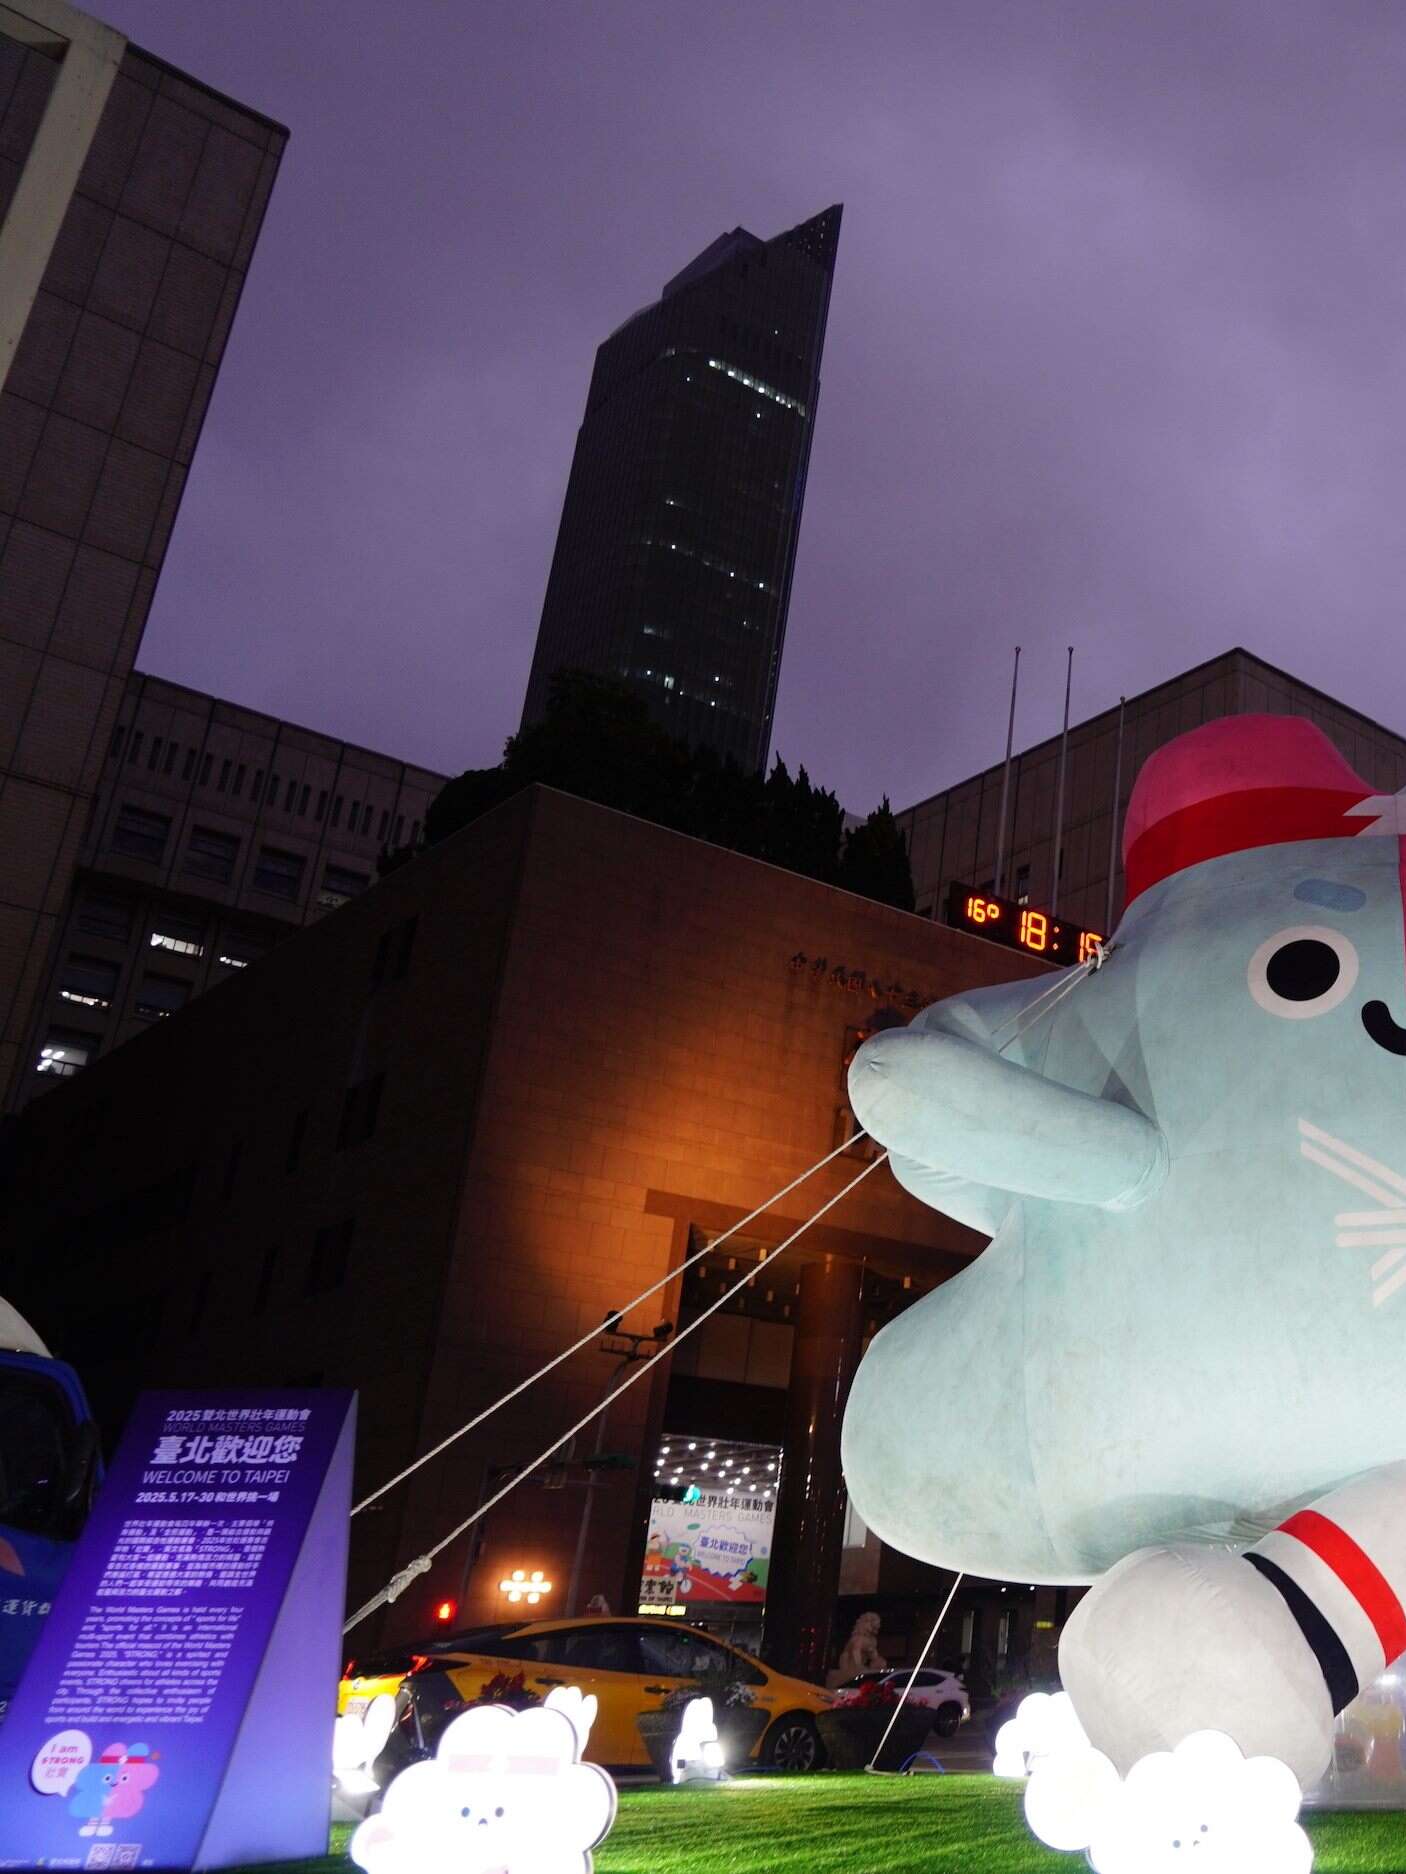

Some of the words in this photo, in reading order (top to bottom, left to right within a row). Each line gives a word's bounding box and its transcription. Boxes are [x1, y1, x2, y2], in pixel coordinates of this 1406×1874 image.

[163, 1422, 206, 1433] WORLD
[208, 1422, 262, 1433] MASTERS
[265, 1421, 306, 1432] GAMES
[150, 1435, 304, 1464] 臺北歡迎您
[143, 1470, 217, 1484] WELCOME
[220, 1470, 242, 1483] TO
[245, 1470, 290, 1483] TAIPEI
[42, 1756, 84, 1764] STRONG
